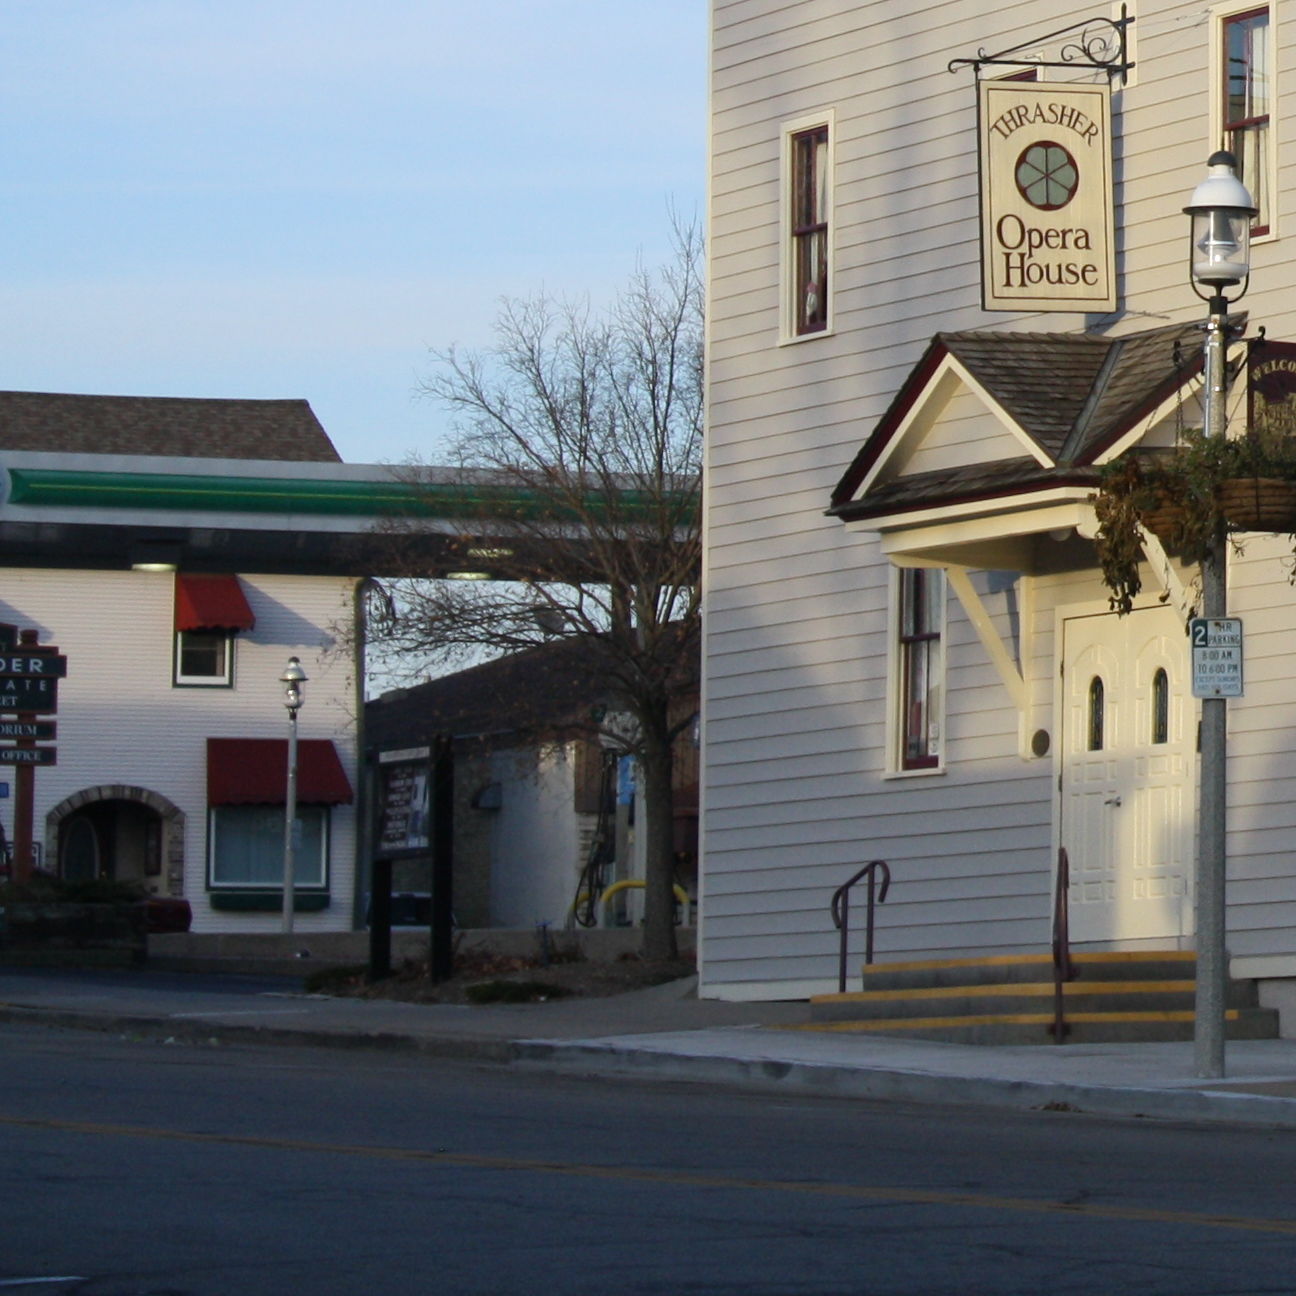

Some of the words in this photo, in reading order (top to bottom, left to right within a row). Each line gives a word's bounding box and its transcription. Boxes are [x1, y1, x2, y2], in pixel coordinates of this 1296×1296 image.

[989, 102, 1099, 147] THRASHER
[996, 213, 1092, 260] Opera
[1002, 252, 1098, 287] House
[1194, 626, 1206, 645] 2
[1208, 634, 1240, 644] PARKING
[1221, 650, 1232, 660] AM
[1227, 664, 1238, 673] PM
[2, 751, 41, 761] OFFICE
